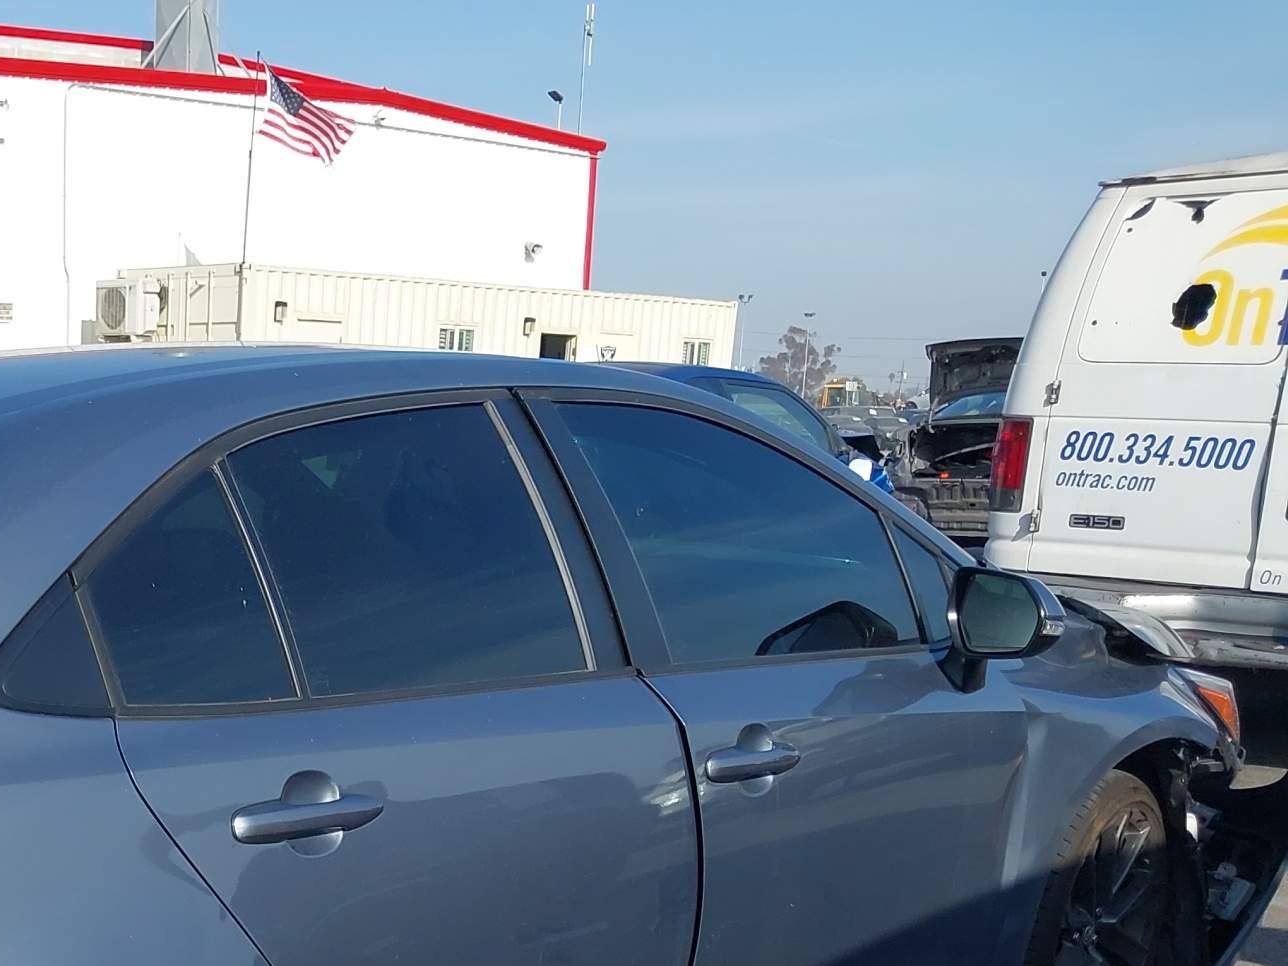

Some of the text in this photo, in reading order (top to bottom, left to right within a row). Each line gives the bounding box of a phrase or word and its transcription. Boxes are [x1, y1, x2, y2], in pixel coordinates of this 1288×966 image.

[1181, 268, 1288, 347] On
[1059, 430, 1256, 471] 800.334.5000
[1055, 469, 1156, 492] ontrac.com
[1259, 569, 1282, 585] On
